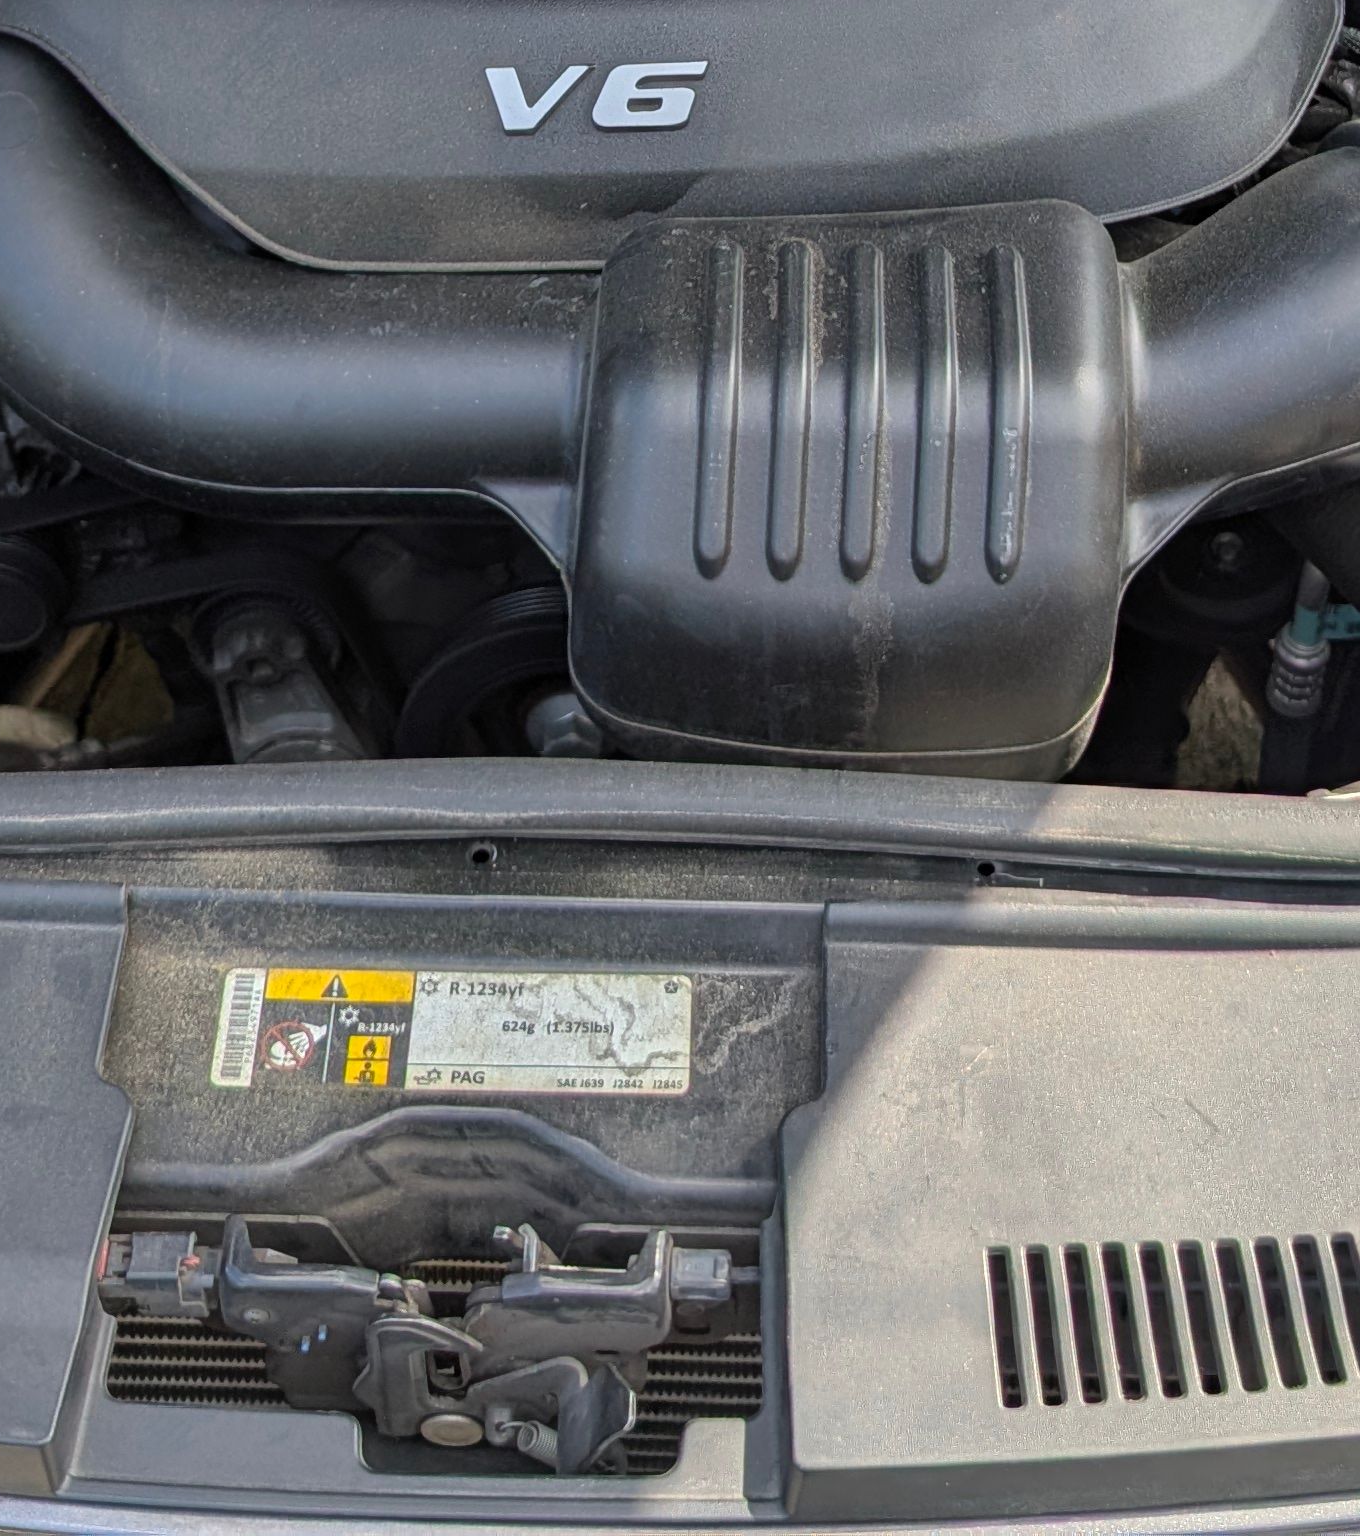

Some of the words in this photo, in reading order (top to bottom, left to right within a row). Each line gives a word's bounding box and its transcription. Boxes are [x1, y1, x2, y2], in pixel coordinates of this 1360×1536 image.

[484, 59, 709, 135] V6
[448, 981, 525, 1000] R-1234yf
[357, 1022, 407, 1035] R-1234yf
[501, 1020, 536, 1035] 624g
[546, 1020, 616, 1036] (1.375lbs)
[450, 1070, 486, 1085] PAG
[556, 1078, 578, 1089] SAE
[579, 1078, 605, 1089] J639
[612, 1078, 644, 1089] J2842
